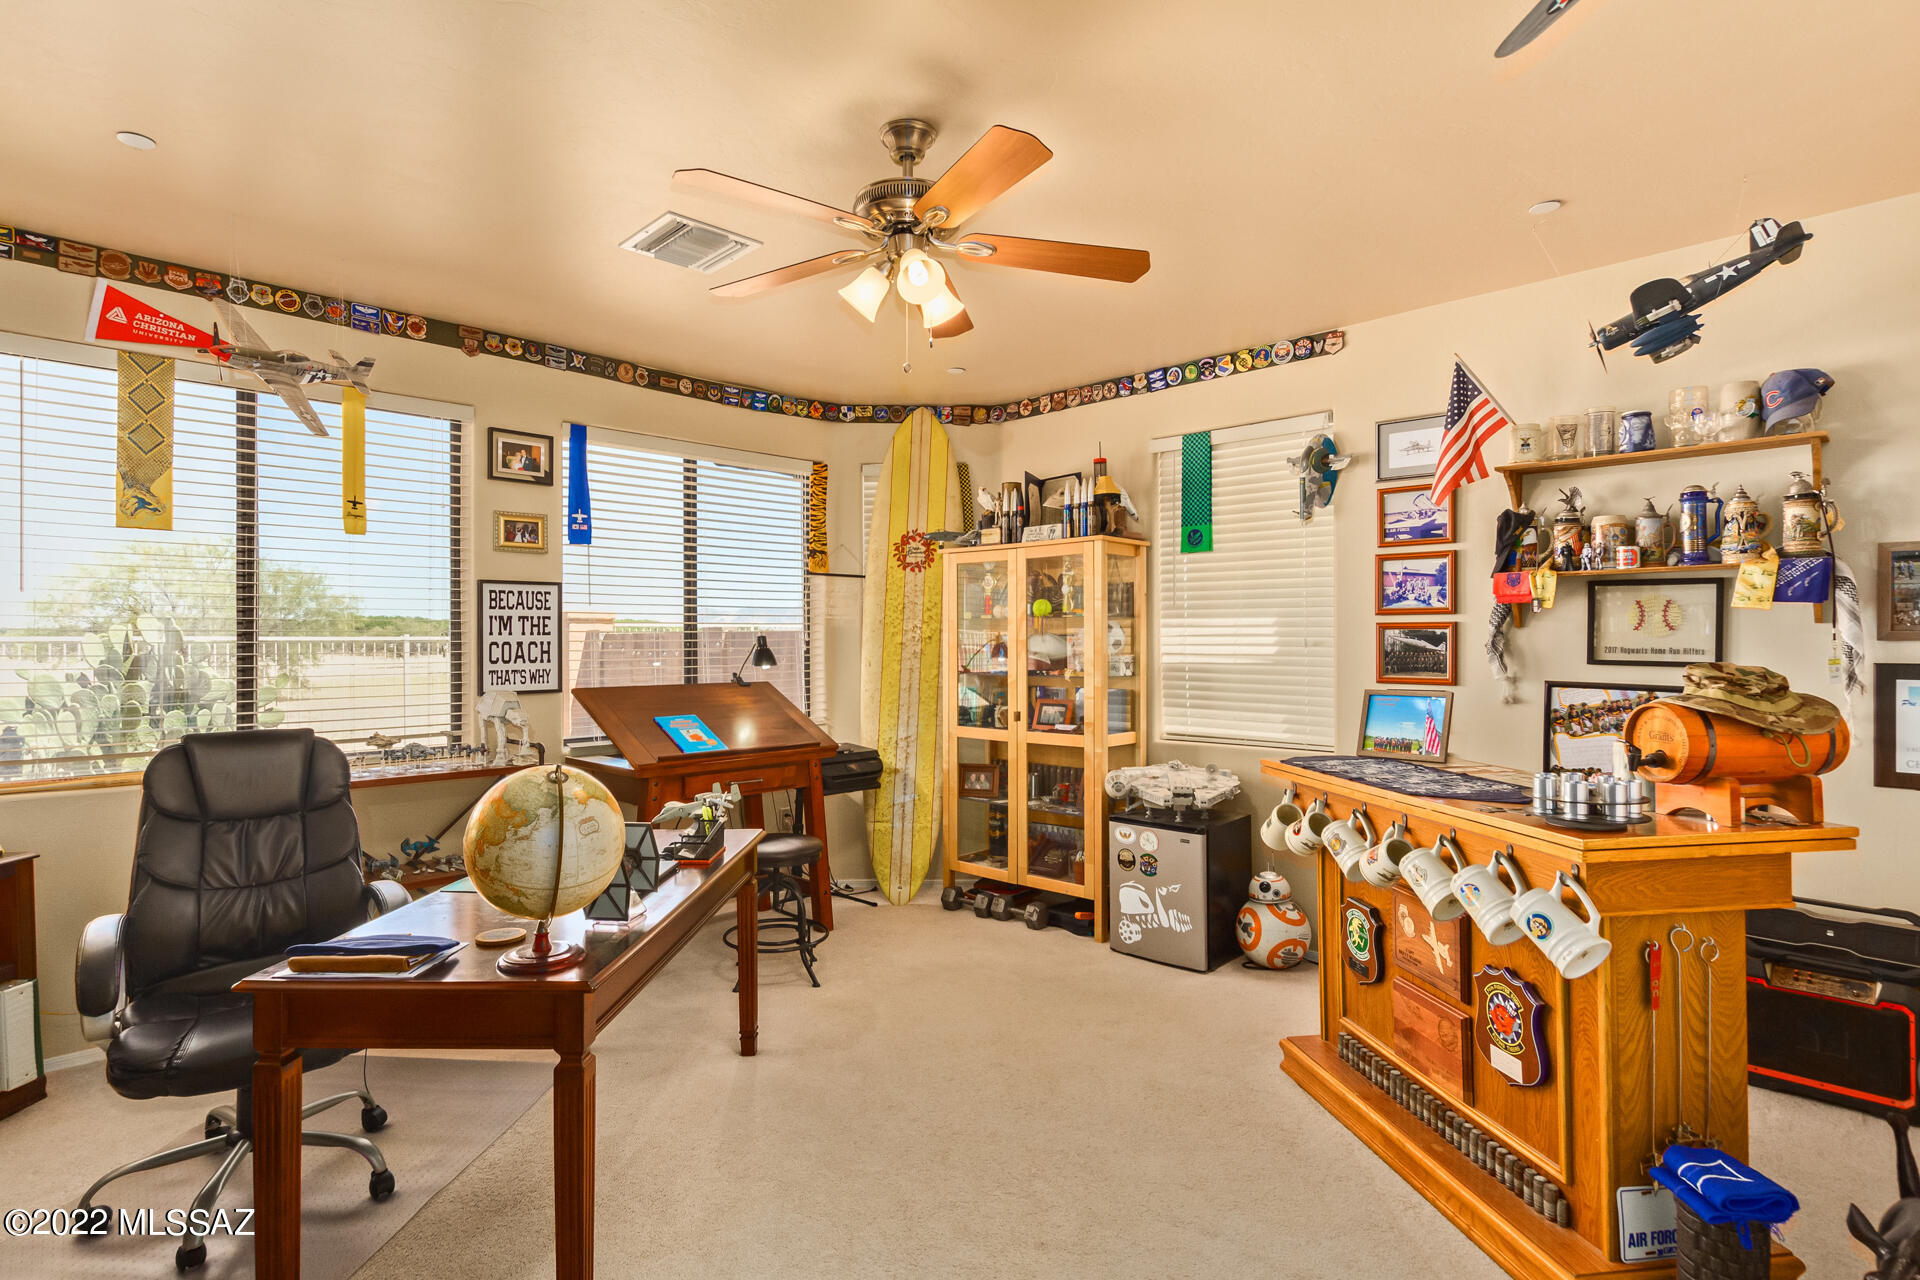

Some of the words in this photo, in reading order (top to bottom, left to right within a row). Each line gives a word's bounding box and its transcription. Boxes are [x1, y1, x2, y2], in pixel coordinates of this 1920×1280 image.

[132, 320, 197, 341] CHRISTIAN
[135, 313, 185, 331] ARIZONA
[132, 329, 184, 343] UNIVERSITY
[1765, 390, 1784, 408] C
[488, 589, 552, 611] BECAUSE
[488, 615, 513, 636] I'M
[518, 615, 552, 636] THE
[488, 640, 552, 664] COACH
[1604, 646, 1618, 654] 2017
[1620, 646, 1648, 655] Hogwarts
[1650, 647, 1666, 655] Home
[1668, 647, 1680, 655] Run
[1682, 647, 1705, 656] Hitters
[488, 669, 527, 686] THAT'S
[528, 668, 552, 684] WHY
[1628, 1231, 1648, 1248] AIR
